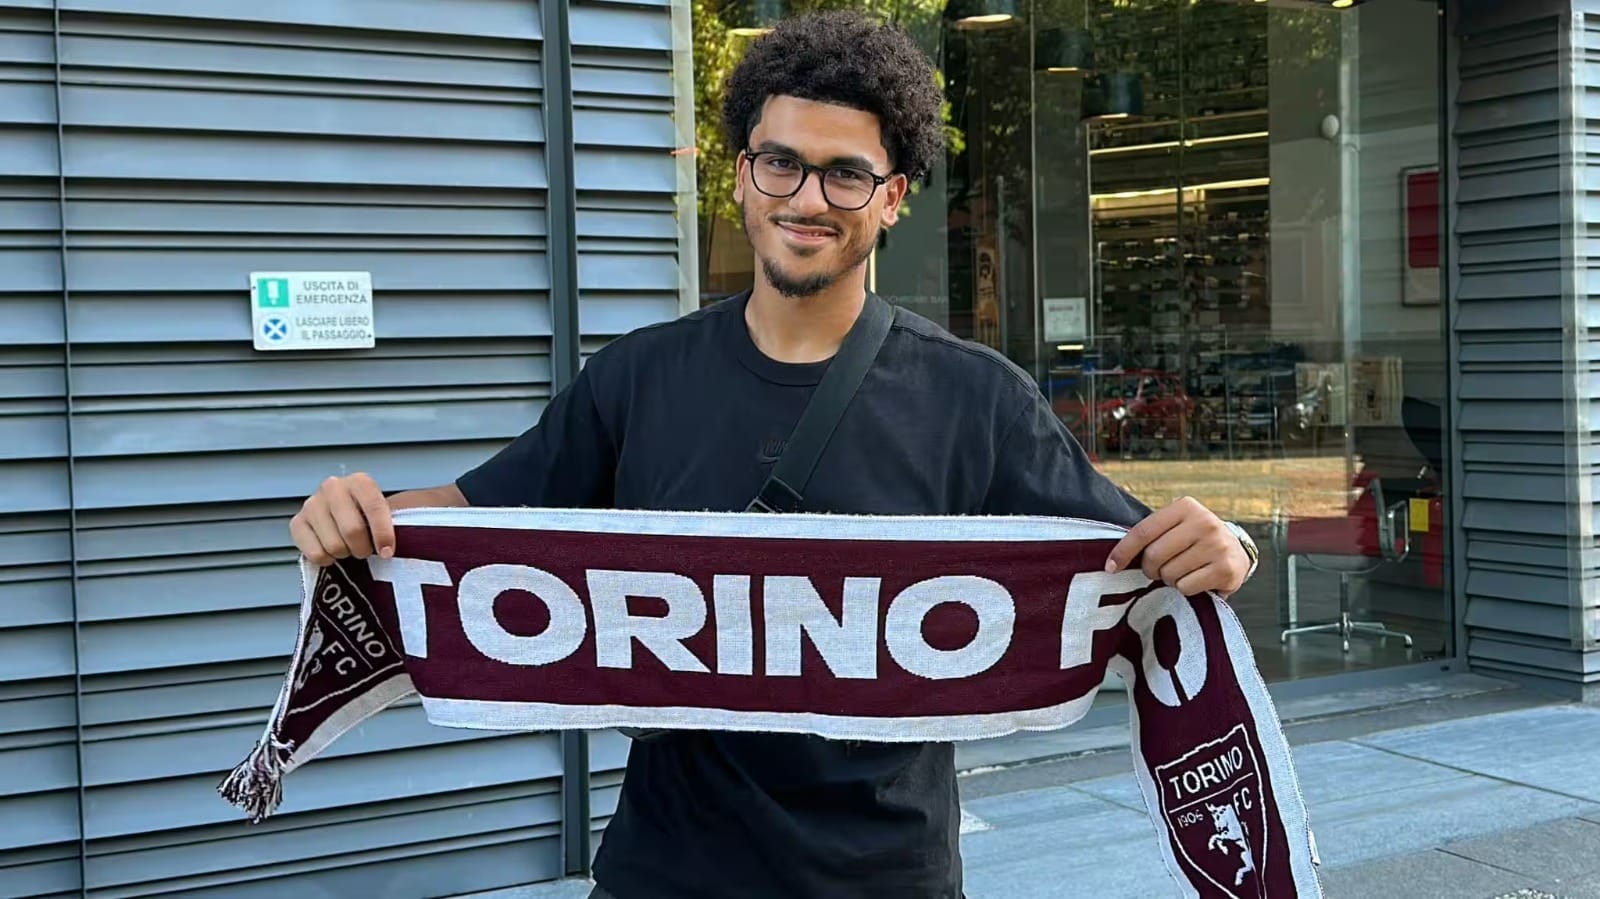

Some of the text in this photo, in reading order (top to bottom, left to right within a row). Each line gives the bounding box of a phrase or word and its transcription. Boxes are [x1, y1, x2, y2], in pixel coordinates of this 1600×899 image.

[303, 280, 359, 291] USCITA DI
[296, 294, 367, 304] EMERGENZA
[295, 315, 370, 327] LASCIARE LIBERO
[302, 329, 366, 340] IL PASSAGGIO
[367, 554, 1015, 680] TORINO
[321, 641, 357, 675] FC
[1169, 746, 1243, 800] TORINO
[1233, 787, 1252, 816] FC
[1177, 809, 1204, 829] 1906
